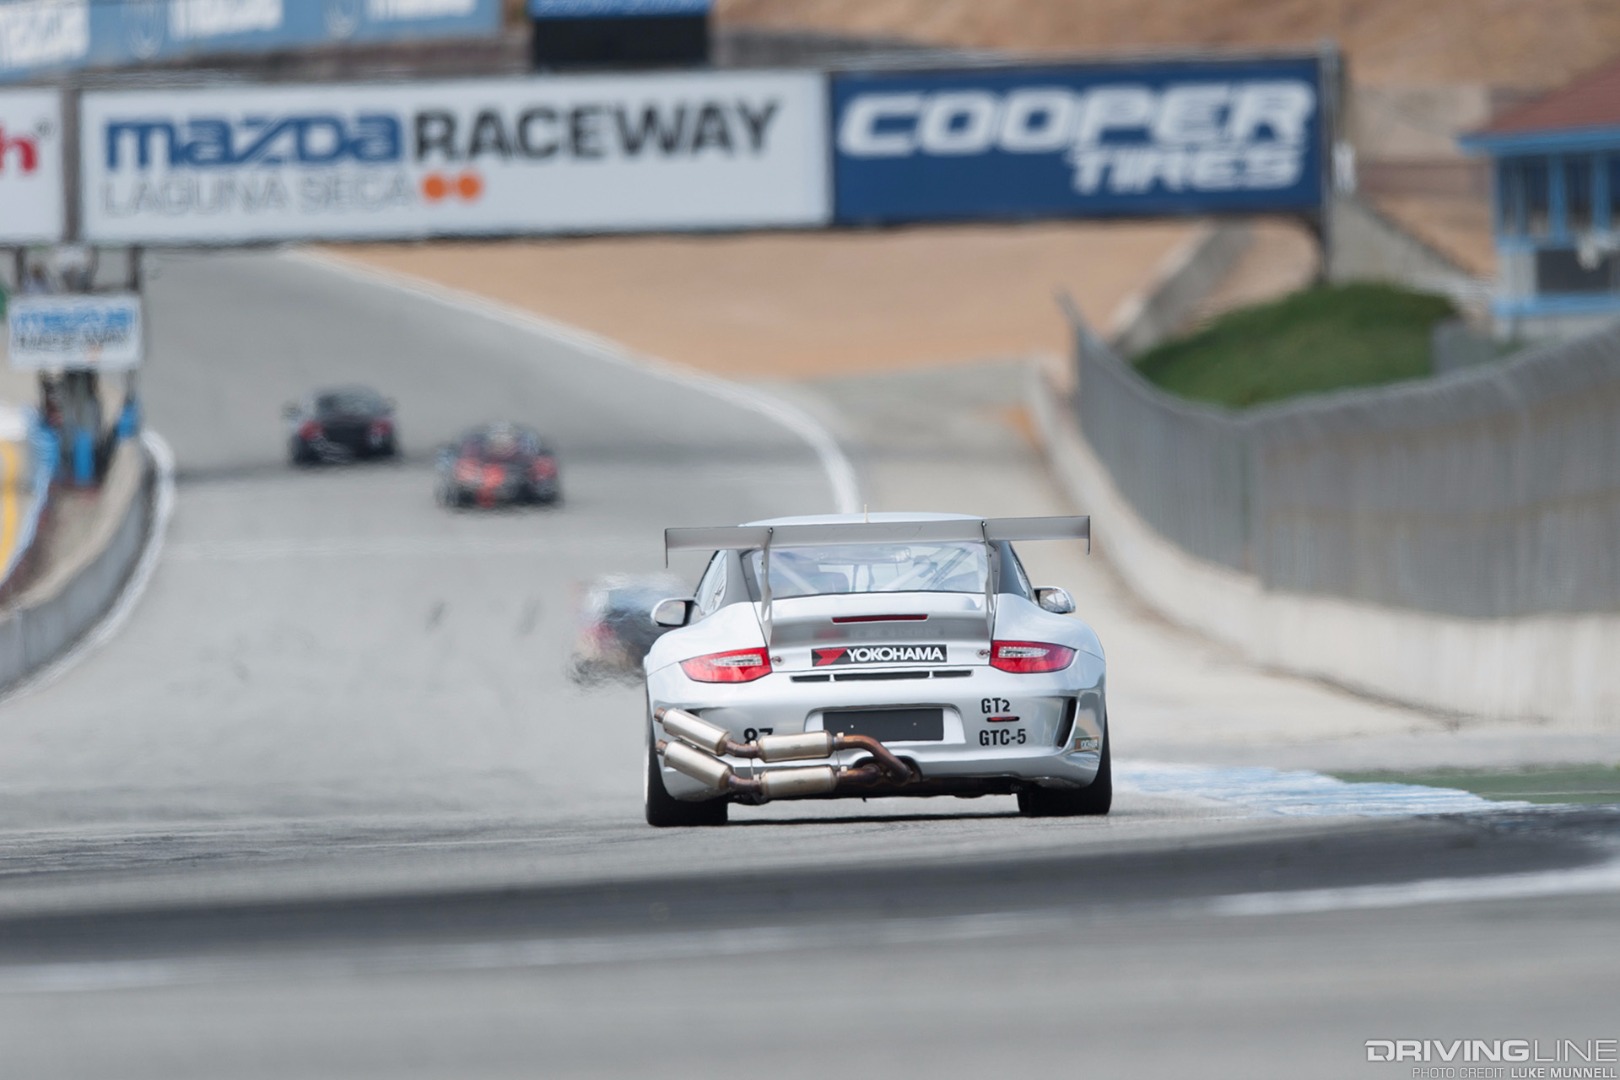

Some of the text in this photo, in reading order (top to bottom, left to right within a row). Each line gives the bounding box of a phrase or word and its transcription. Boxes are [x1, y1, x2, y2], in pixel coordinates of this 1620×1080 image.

[103, 97, 779, 171] mazda RACEWAY
[837, 80, 1315, 157] COOPER
[1070, 145, 1302, 193] TIRES
[102, 170, 414, 217] LAGUNA SECA
[847, 647, 945, 663] YOKOHAMA
[981, 698, 1011, 714] GT2
[980, 729, 1027, 746] GTC-5
